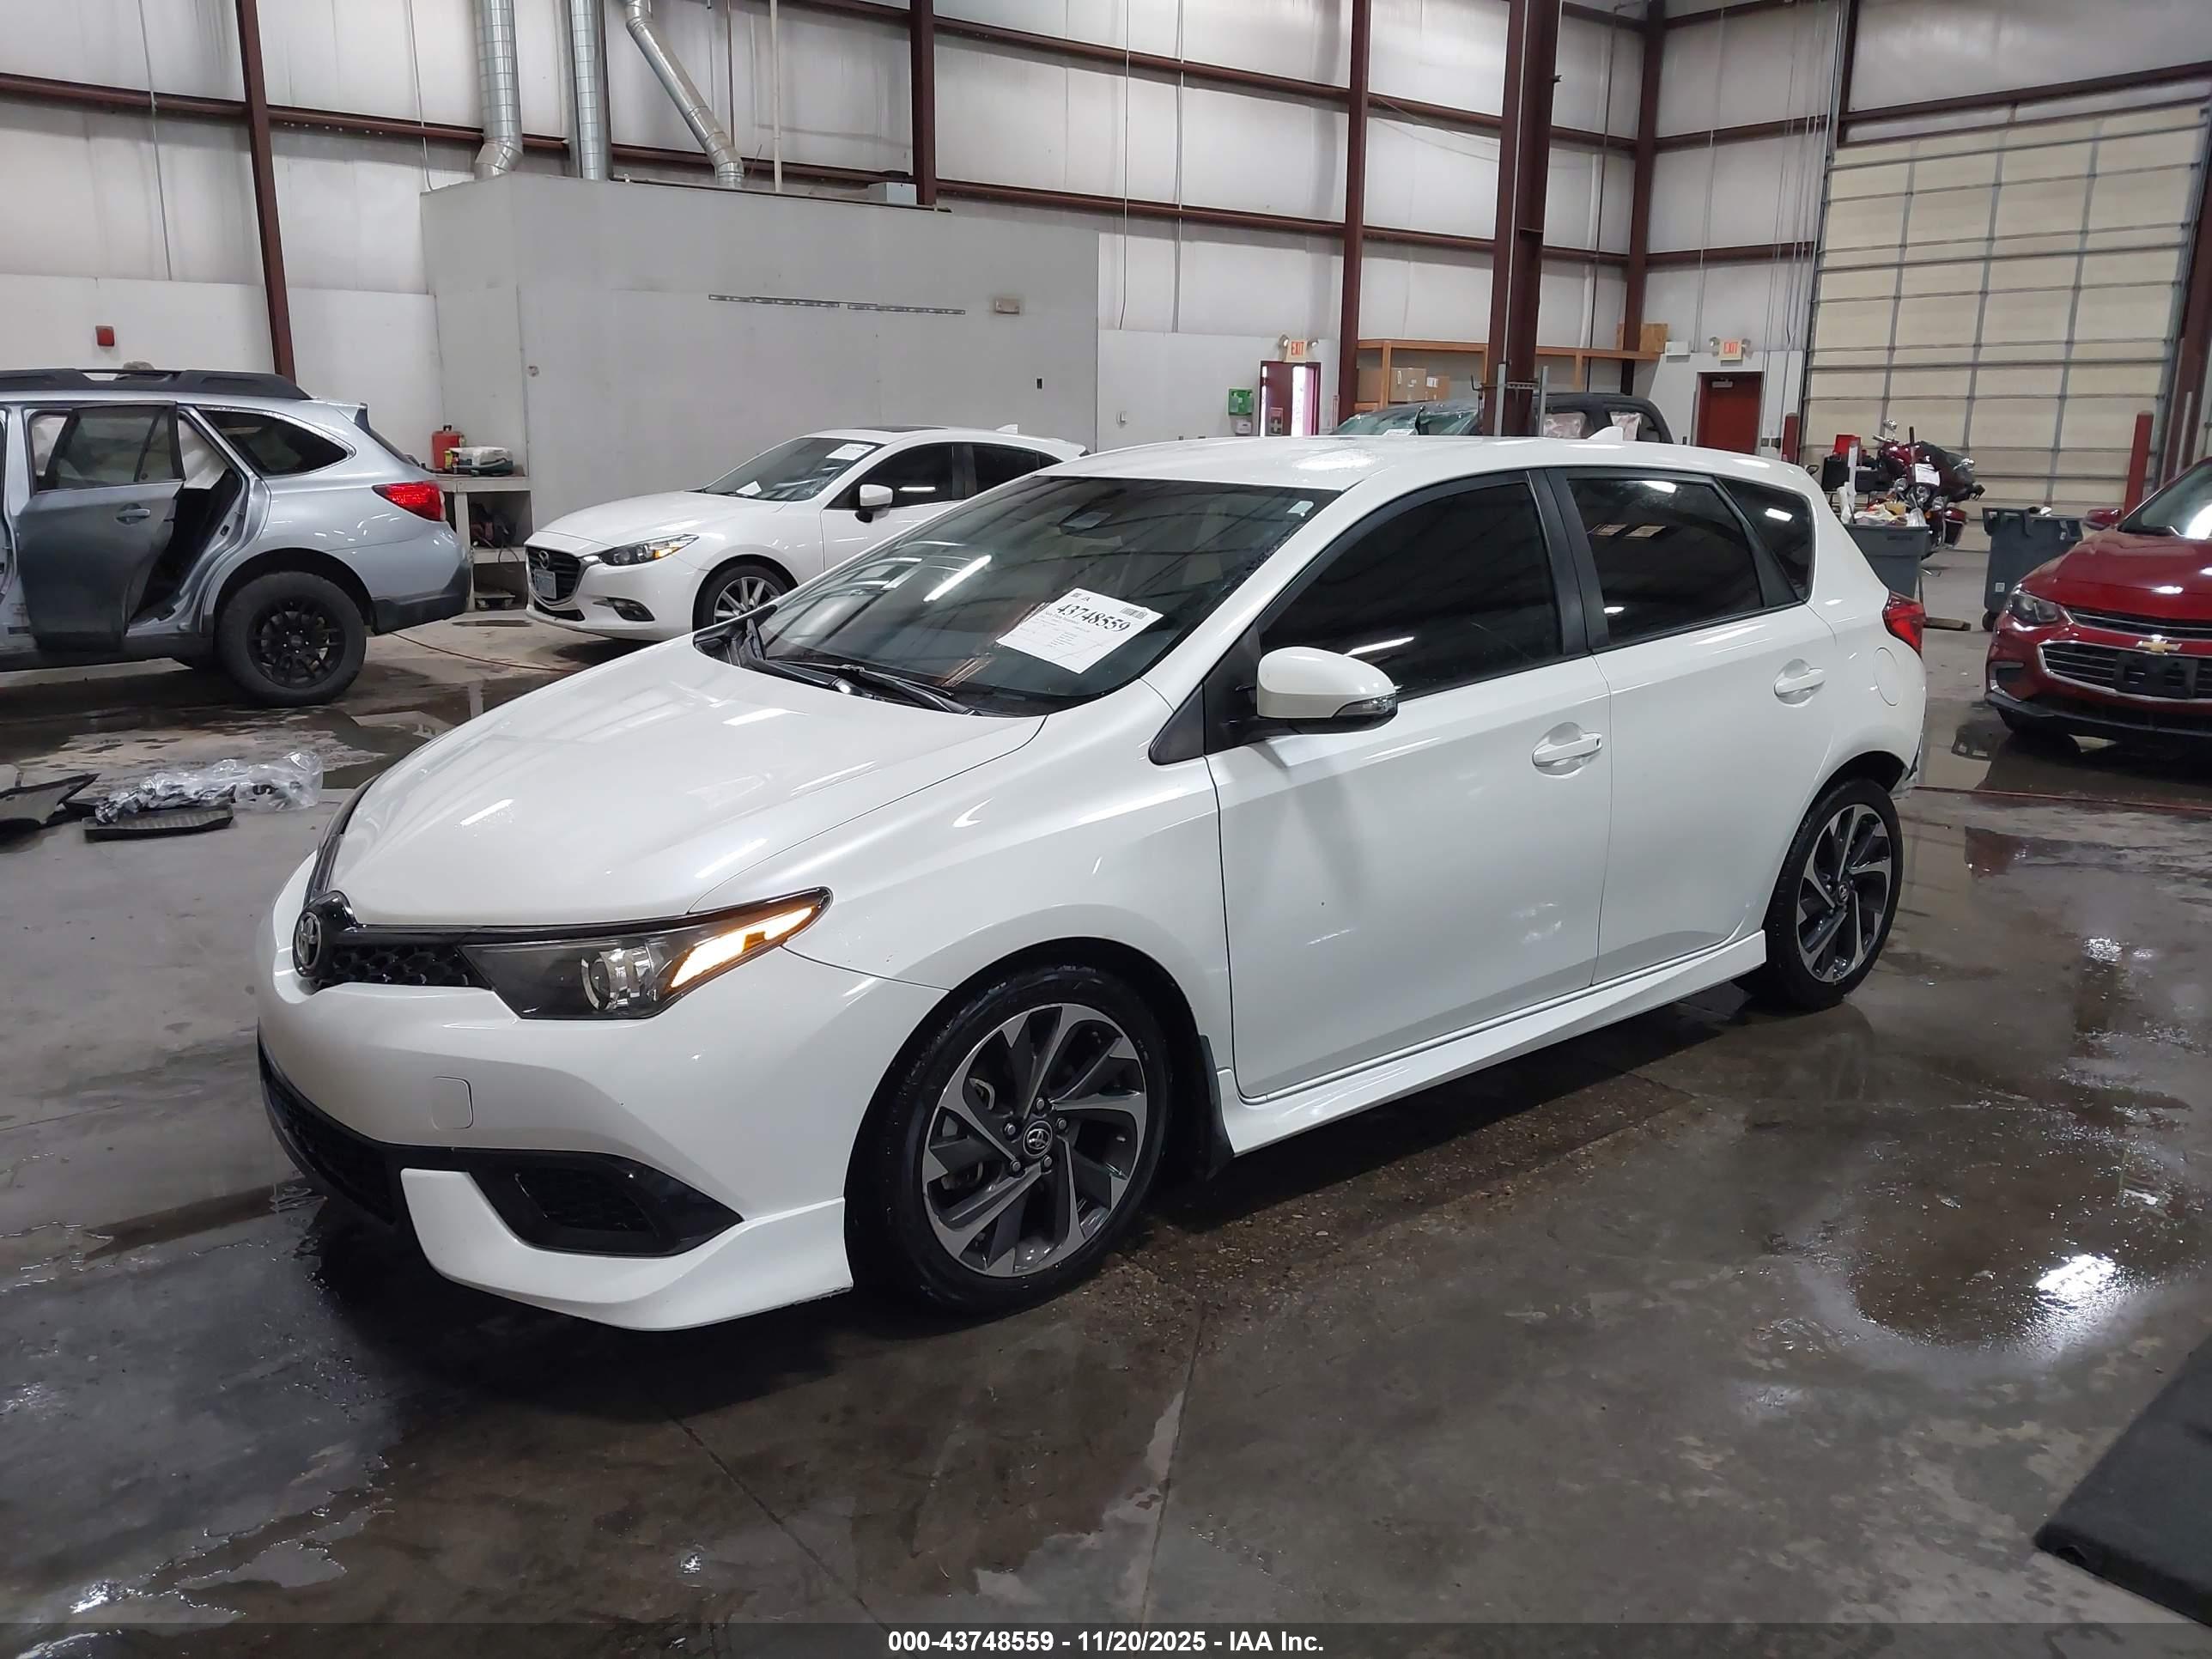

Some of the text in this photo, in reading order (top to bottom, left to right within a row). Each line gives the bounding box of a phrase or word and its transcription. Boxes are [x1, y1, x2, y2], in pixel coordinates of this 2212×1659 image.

[1291, 341, 1304, 356] EXIT
[1723, 341, 1738, 355] EXIT
[1056, 604, 1132, 632] 43748559
